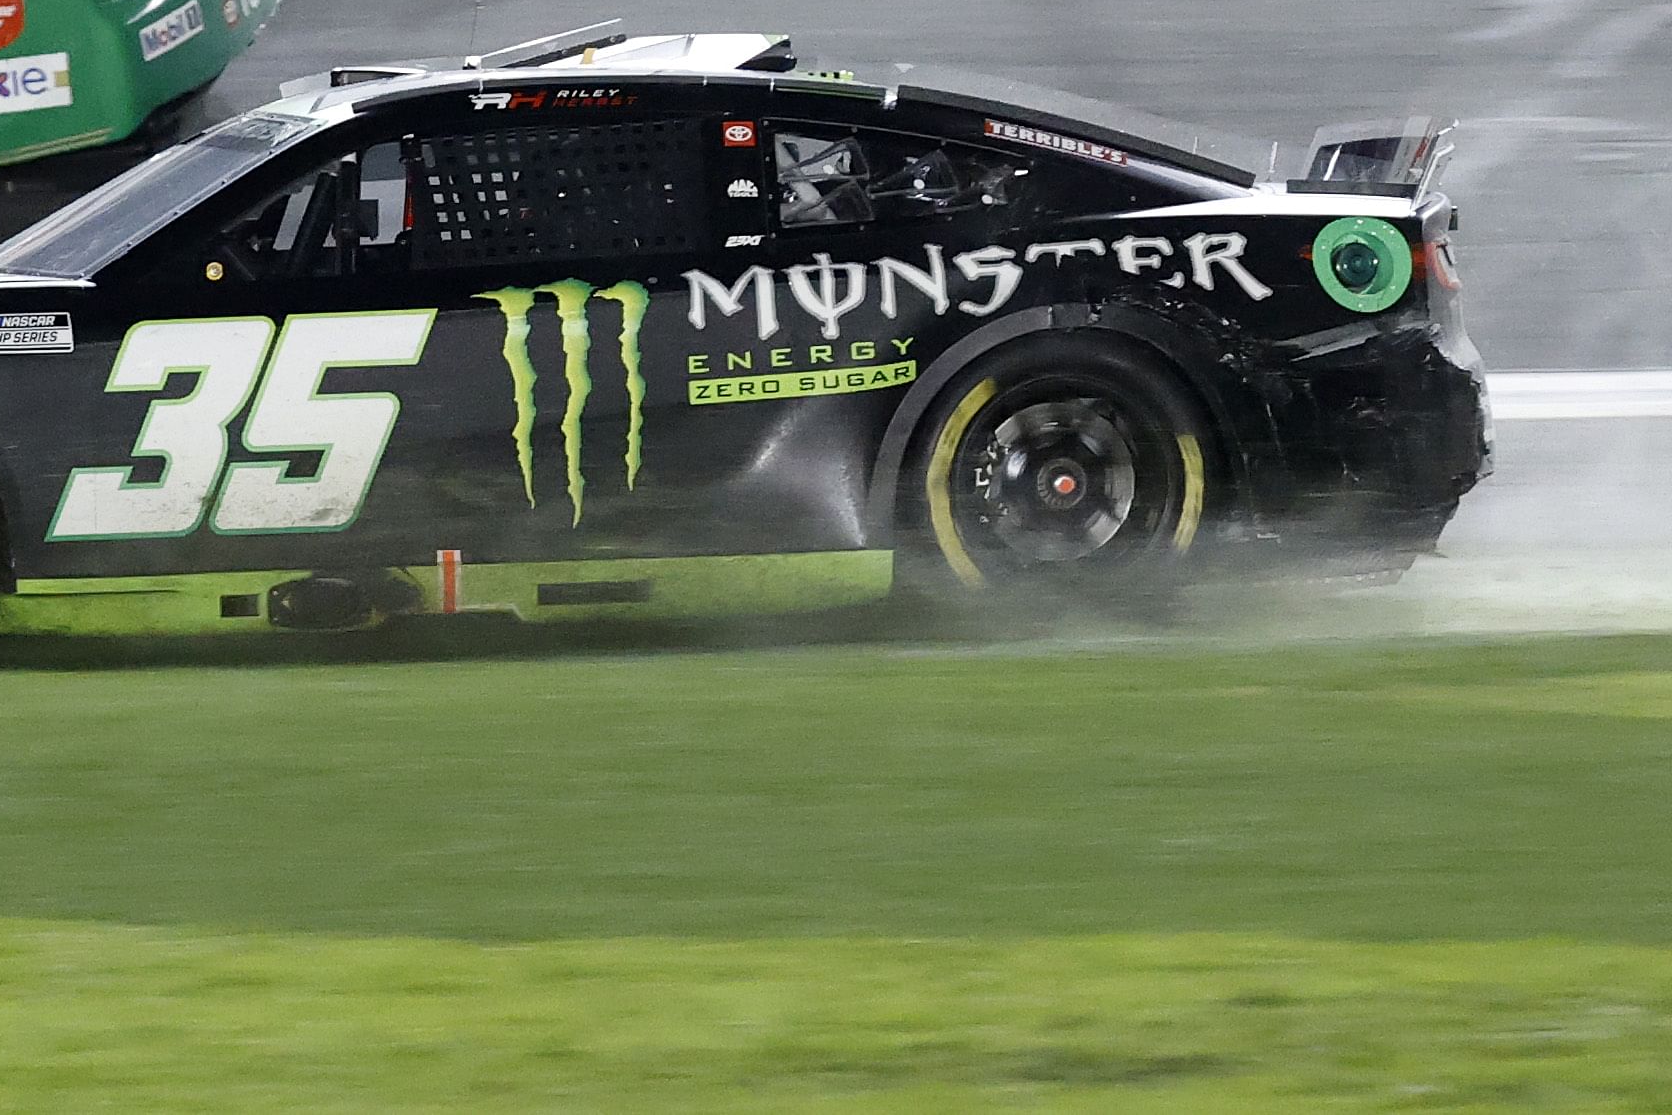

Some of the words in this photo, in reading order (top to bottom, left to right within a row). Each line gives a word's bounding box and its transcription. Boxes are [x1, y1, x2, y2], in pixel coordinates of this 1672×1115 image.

[556, 88, 621, 99] RILEY
[990, 122, 1127, 166] TERRIBLE'S
[681, 232, 1274, 340] MONSTER
[1, 315, 56, 328] NASCAR
[12, 331, 58, 344] SERIES
[688, 337, 917, 375] ENERGY
[694, 378, 781, 400] ZERO
[798, 366, 913, 391] SUGAR
[44, 308, 439, 543] 35
